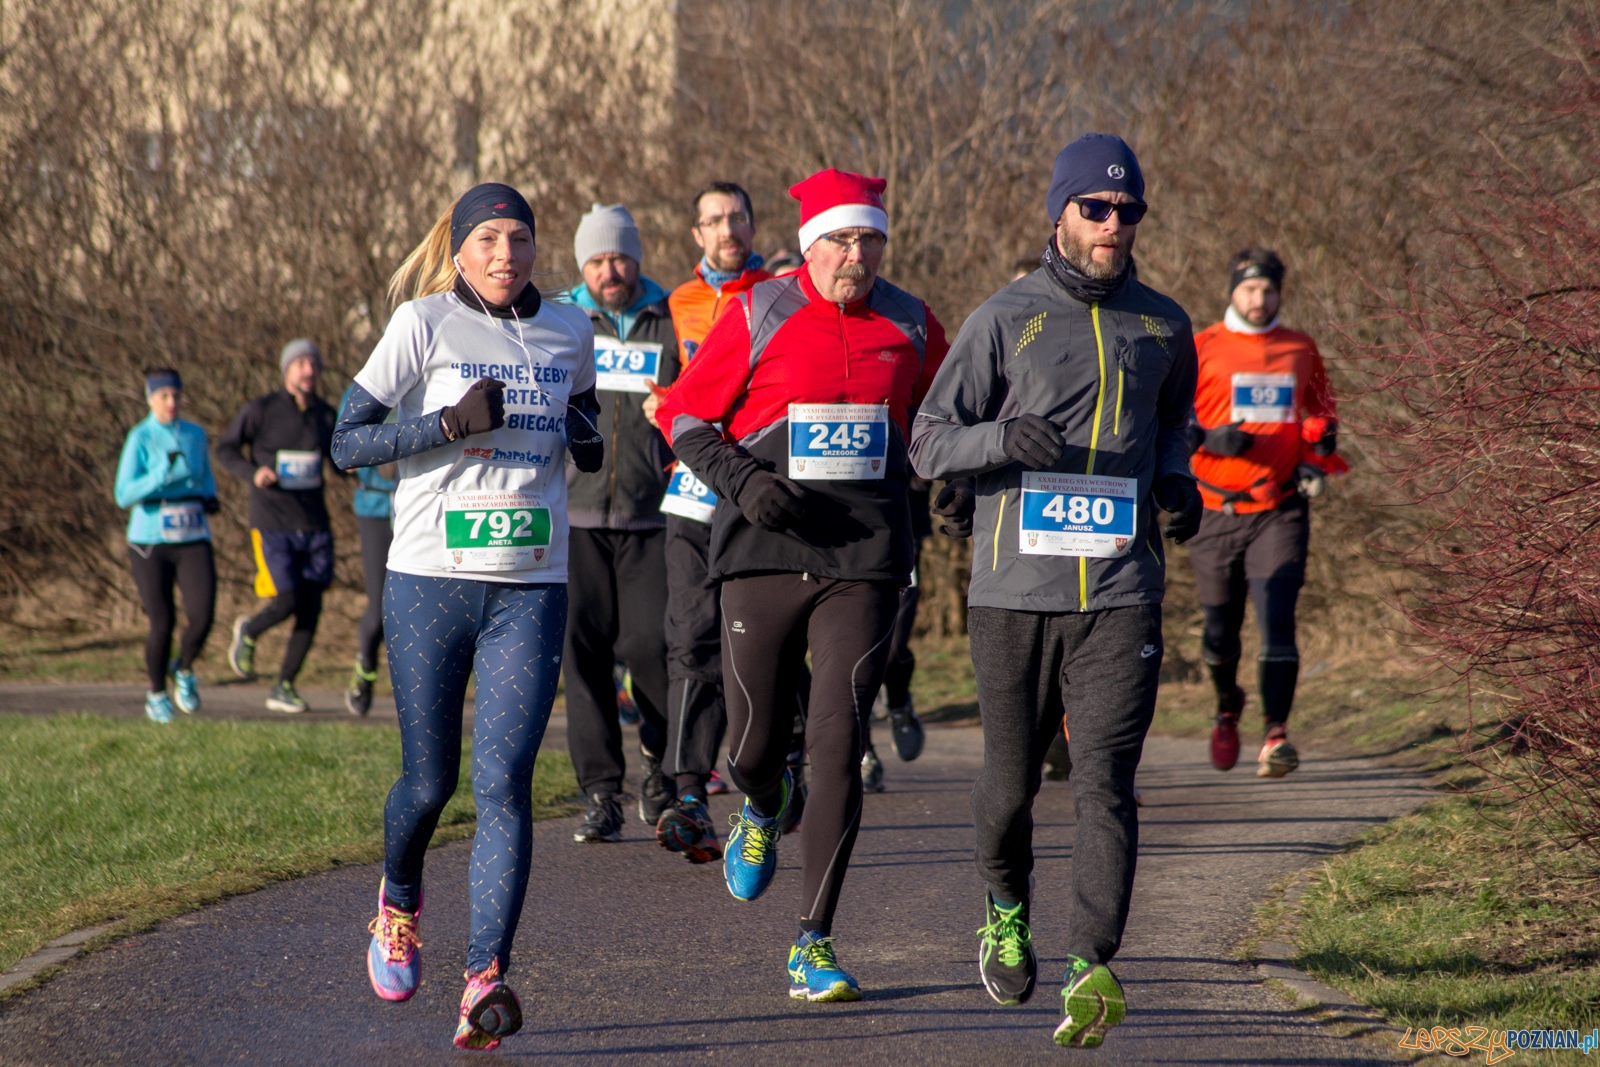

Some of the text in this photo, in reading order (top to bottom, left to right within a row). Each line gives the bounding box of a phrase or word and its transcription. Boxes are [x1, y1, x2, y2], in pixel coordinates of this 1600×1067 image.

[596, 350, 646, 370] 479
[534, 362, 568, 384] ŻEBY
[1250, 386, 1278, 404] 99
[808, 423, 871, 450] 245
[1076, 478, 1128, 488] SYLWESTROWY
[1042, 494, 1115, 525] 480
[464, 510, 533, 539] 792
